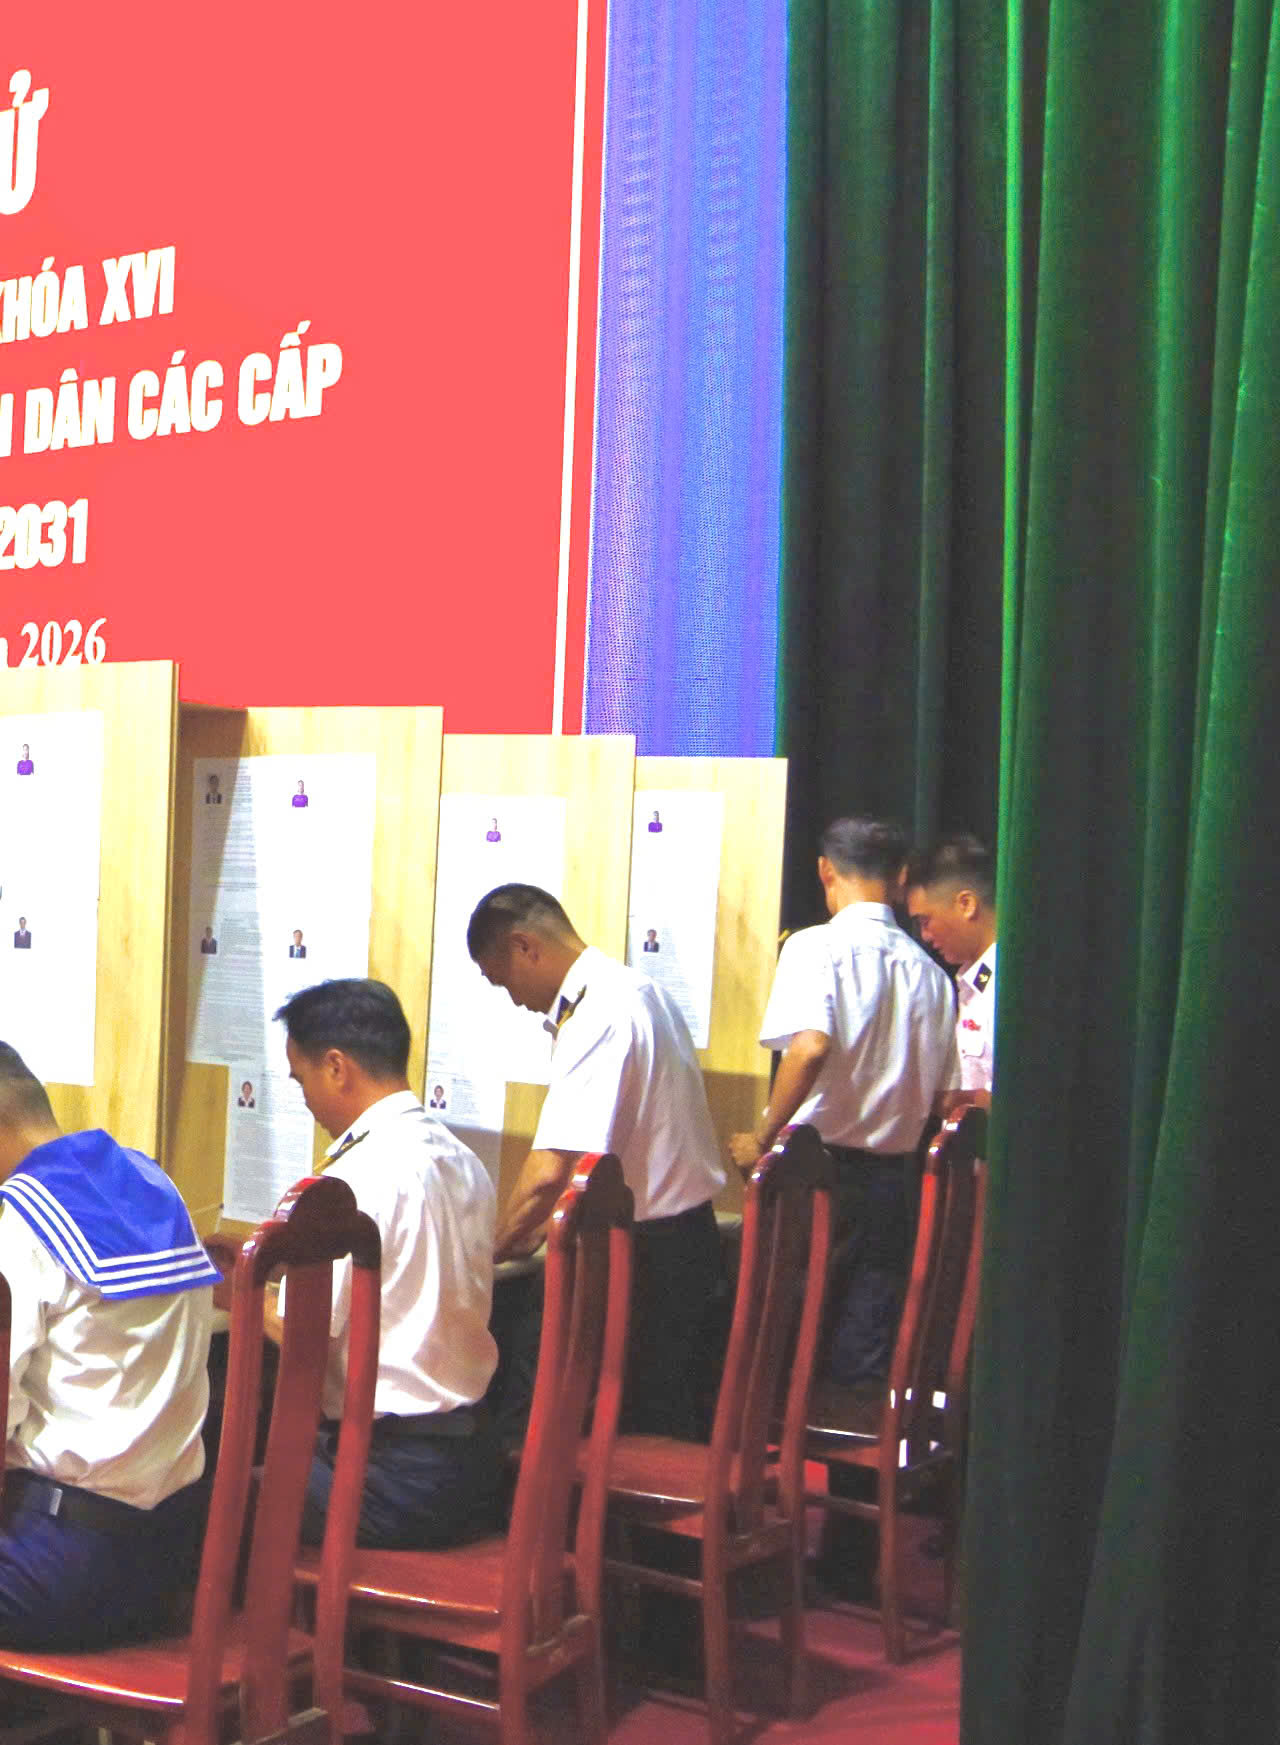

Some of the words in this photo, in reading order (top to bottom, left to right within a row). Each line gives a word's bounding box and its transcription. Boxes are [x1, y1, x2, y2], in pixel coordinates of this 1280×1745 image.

[99, 246, 175, 325] XVI
[24, 368, 116, 454] DÂN
[128, 350, 223, 440] CÁC
[238, 320, 342, 425] CẤP
[19, 618, 107, 665] 2026
